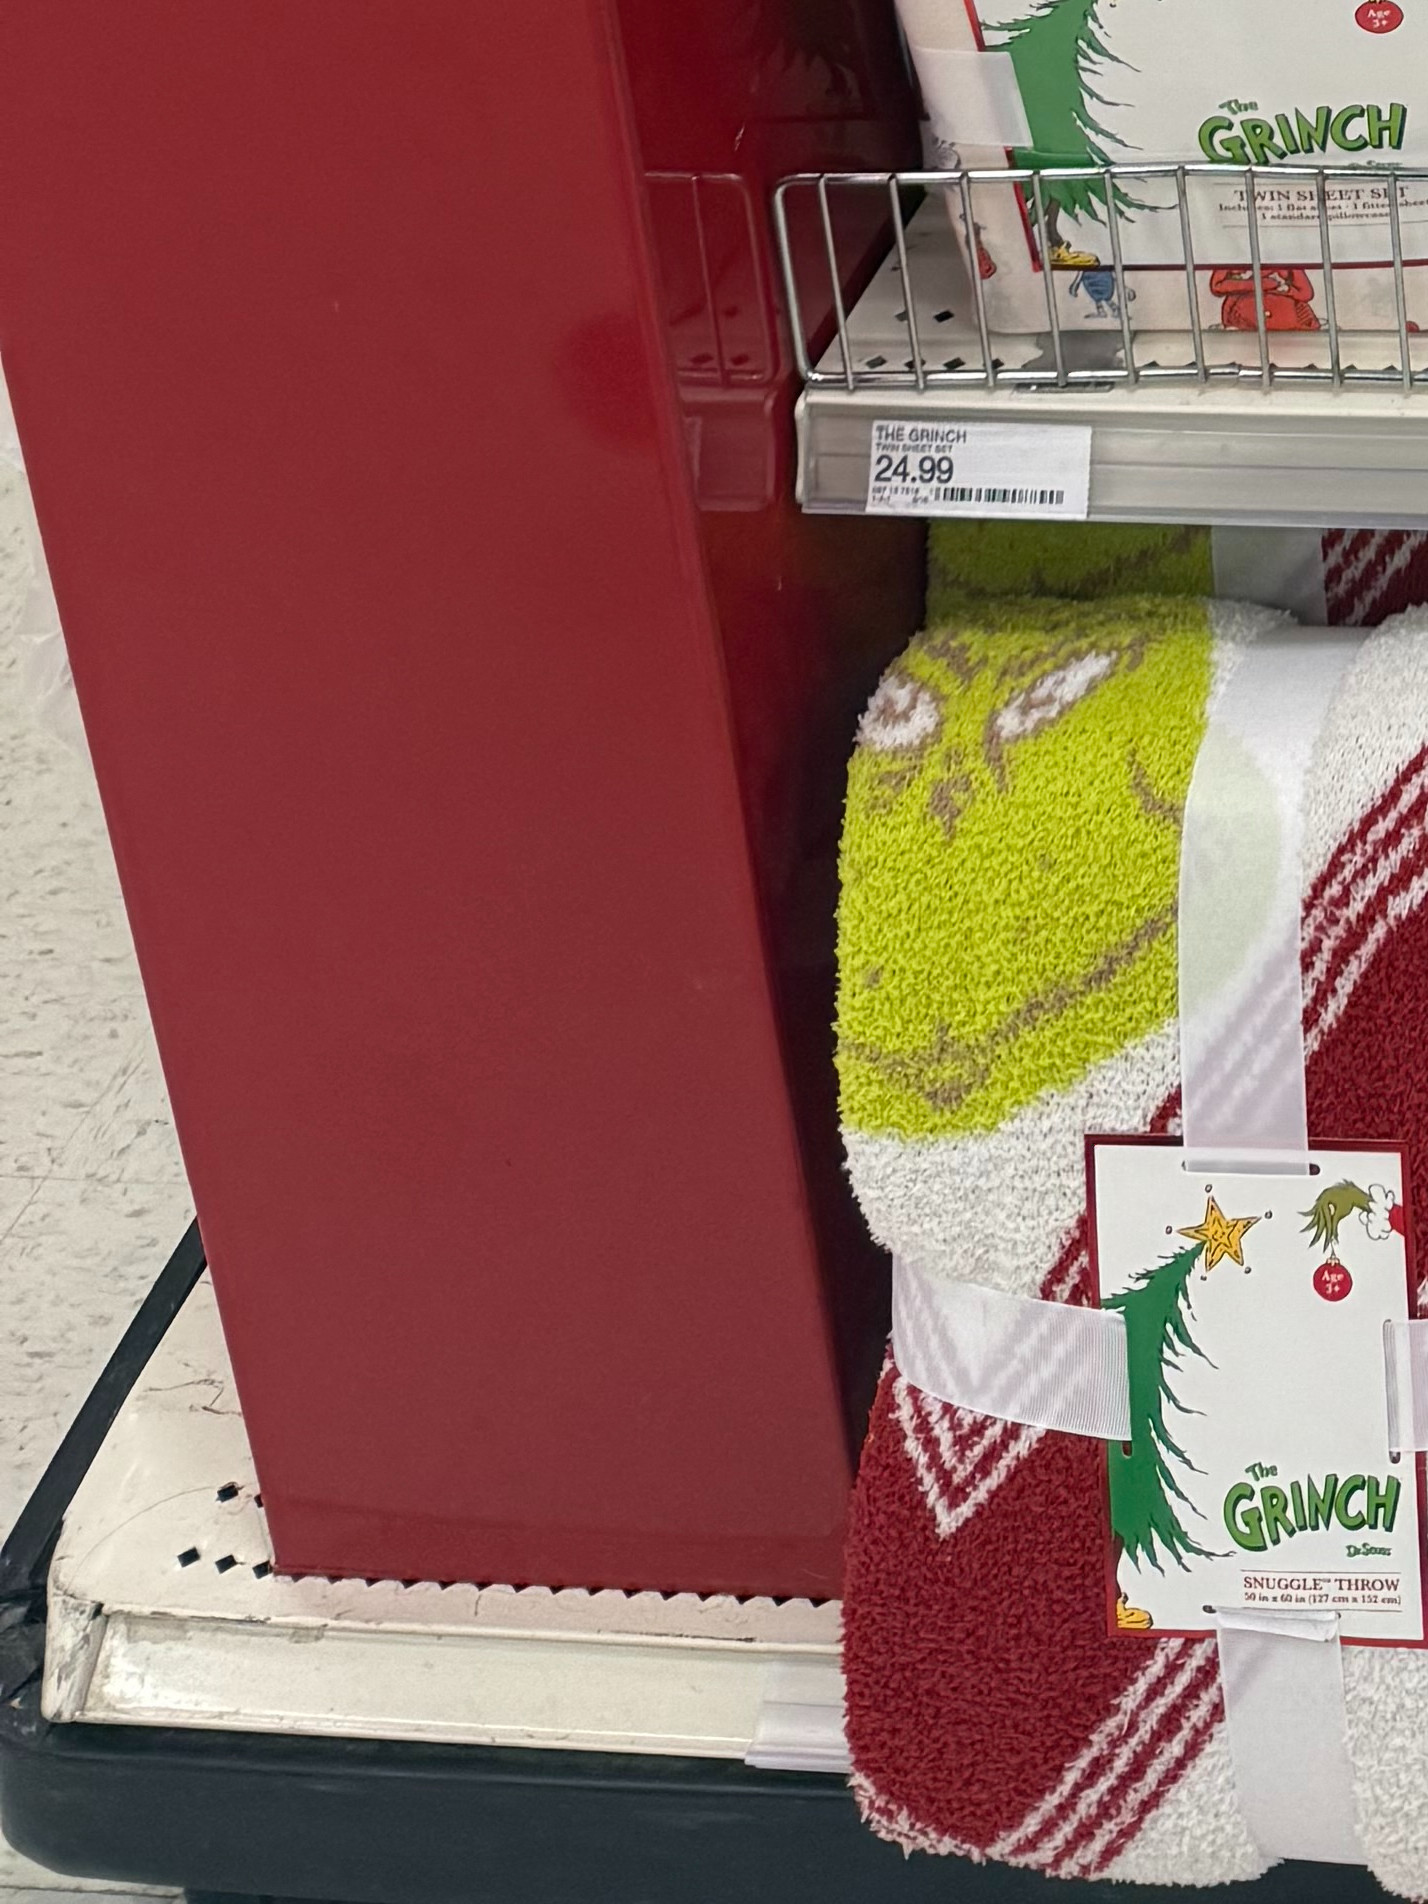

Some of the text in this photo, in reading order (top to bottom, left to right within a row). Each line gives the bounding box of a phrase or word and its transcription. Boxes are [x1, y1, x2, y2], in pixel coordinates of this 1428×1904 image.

[1367, 7, 1391, 19] Age
[1219, 99, 1258, 115] The
[1198, 103, 1408, 164] GRINCH
[875, 426, 967, 443] THE GRINCH
[875, 444, 952, 453] TWIN SHEET SET
[874, 455, 954, 484] 24.99
[1322, 1271, 1344, 1284] Age
[1245, 1462, 1277, 1481] The
[1224, 1473, 1401, 1552] GRINCH
[1335, 1579, 1400, 1591] THROW
[1308, 1594, 1329, 1605] (127
[1361, 1596, 1378, 1604] 152
